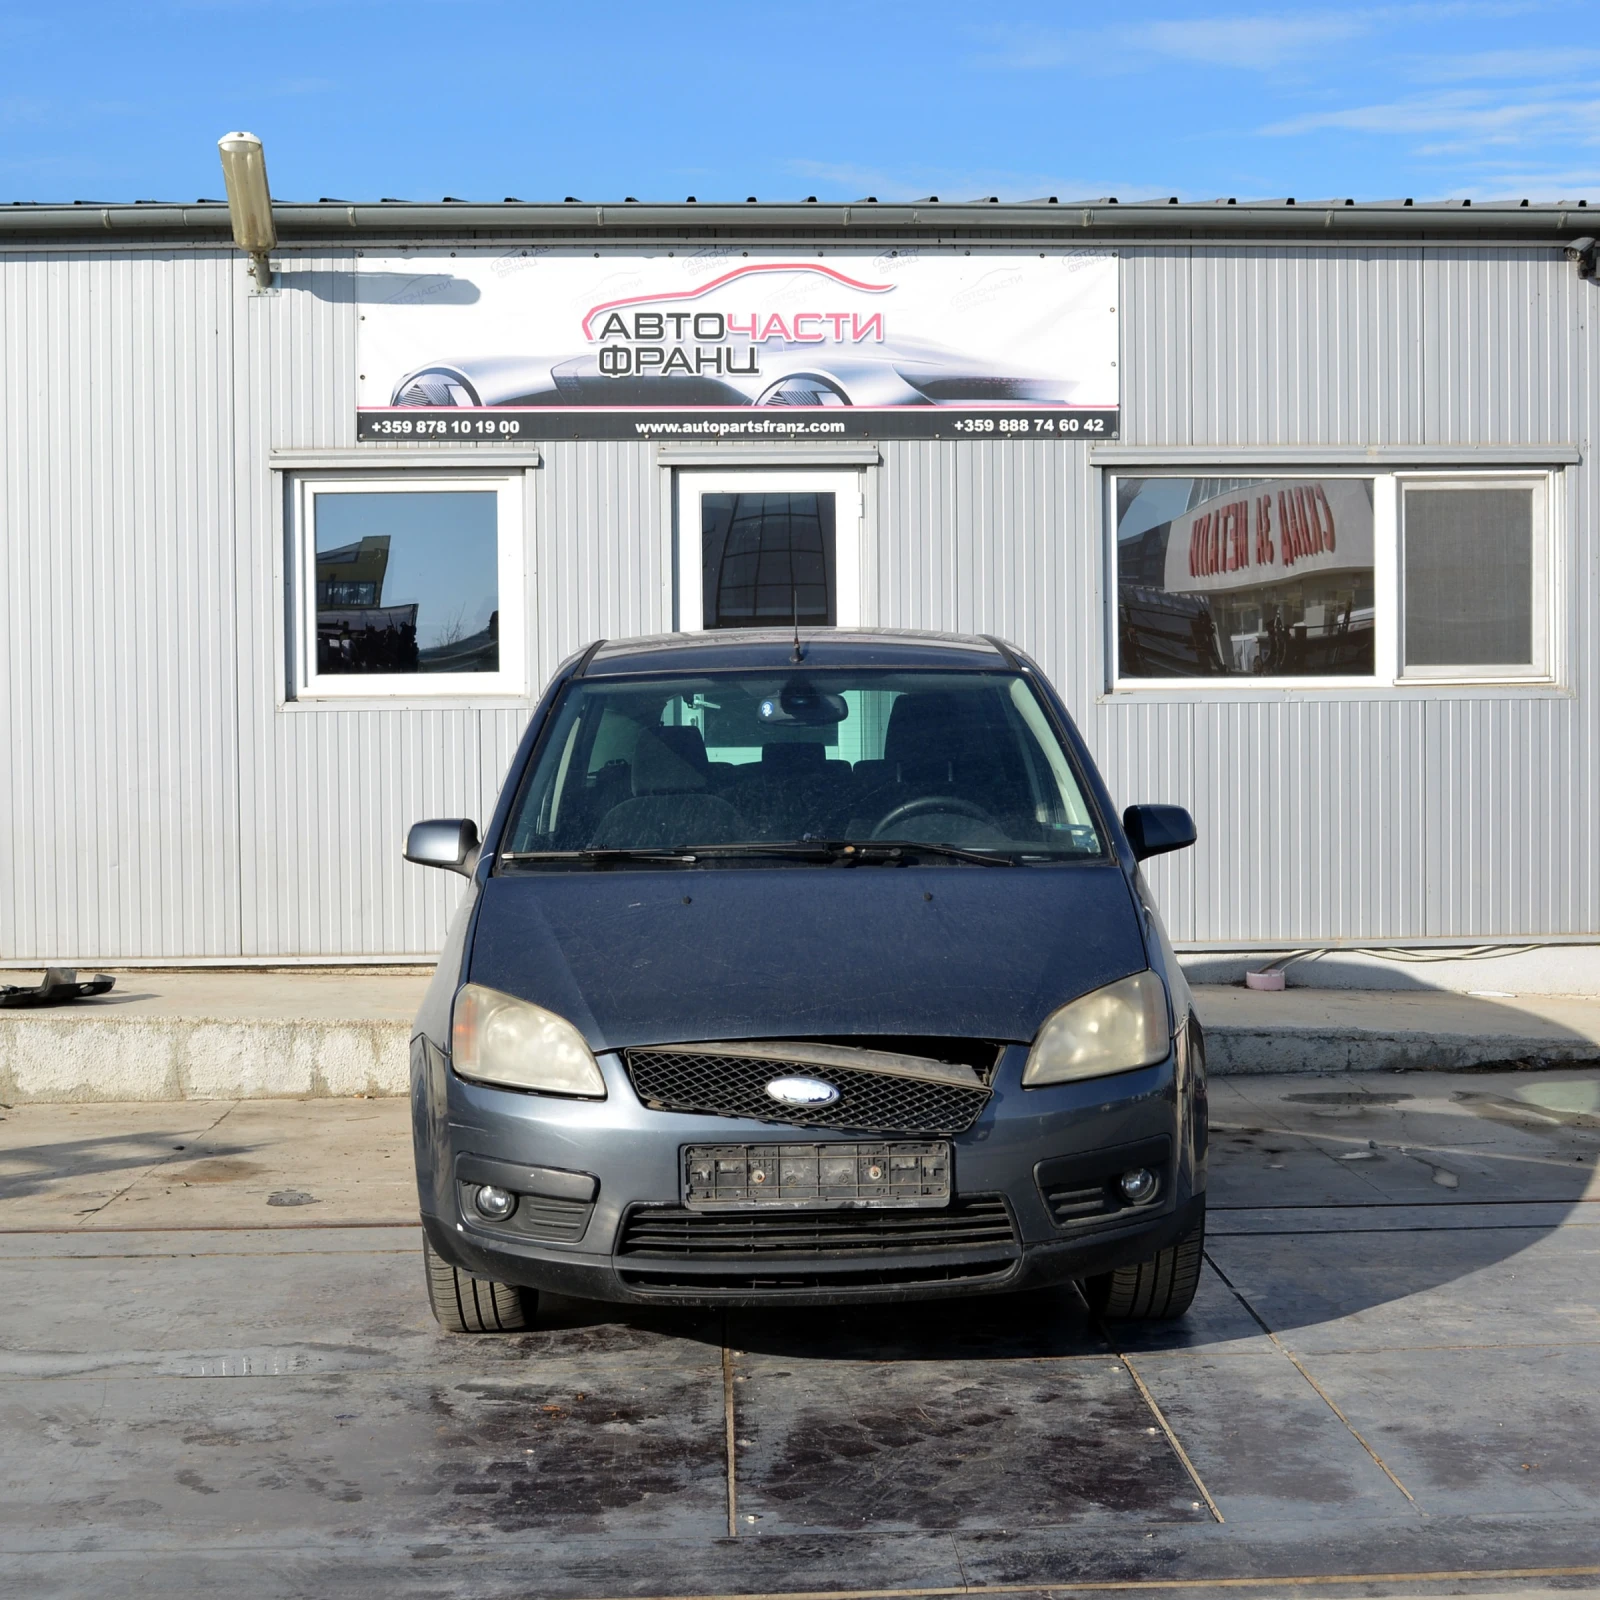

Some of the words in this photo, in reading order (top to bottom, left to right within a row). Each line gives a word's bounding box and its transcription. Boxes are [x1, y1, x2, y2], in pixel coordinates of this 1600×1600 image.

[599, 313, 882, 341] АВТОЧАСТИ
[599, 345, 760, 378] ФРАНЦ
[371, 420, 413, 434] +359
[416, 420, 447, 434] 878
[451, 420, 472, 434] 10
[475, 420, 496, 434] 19
[499, 420, 520, 434] 00
[635, 419, 846, 436] www.autopartsfranz.com
[954, 418, 994, 433] +359
[999, 418, 1029, 432] 888
[1034, 418, 1055, 432] 74
[1059, 418, 1080, 432] 60
[1083, 418, 1104, 432] 42
